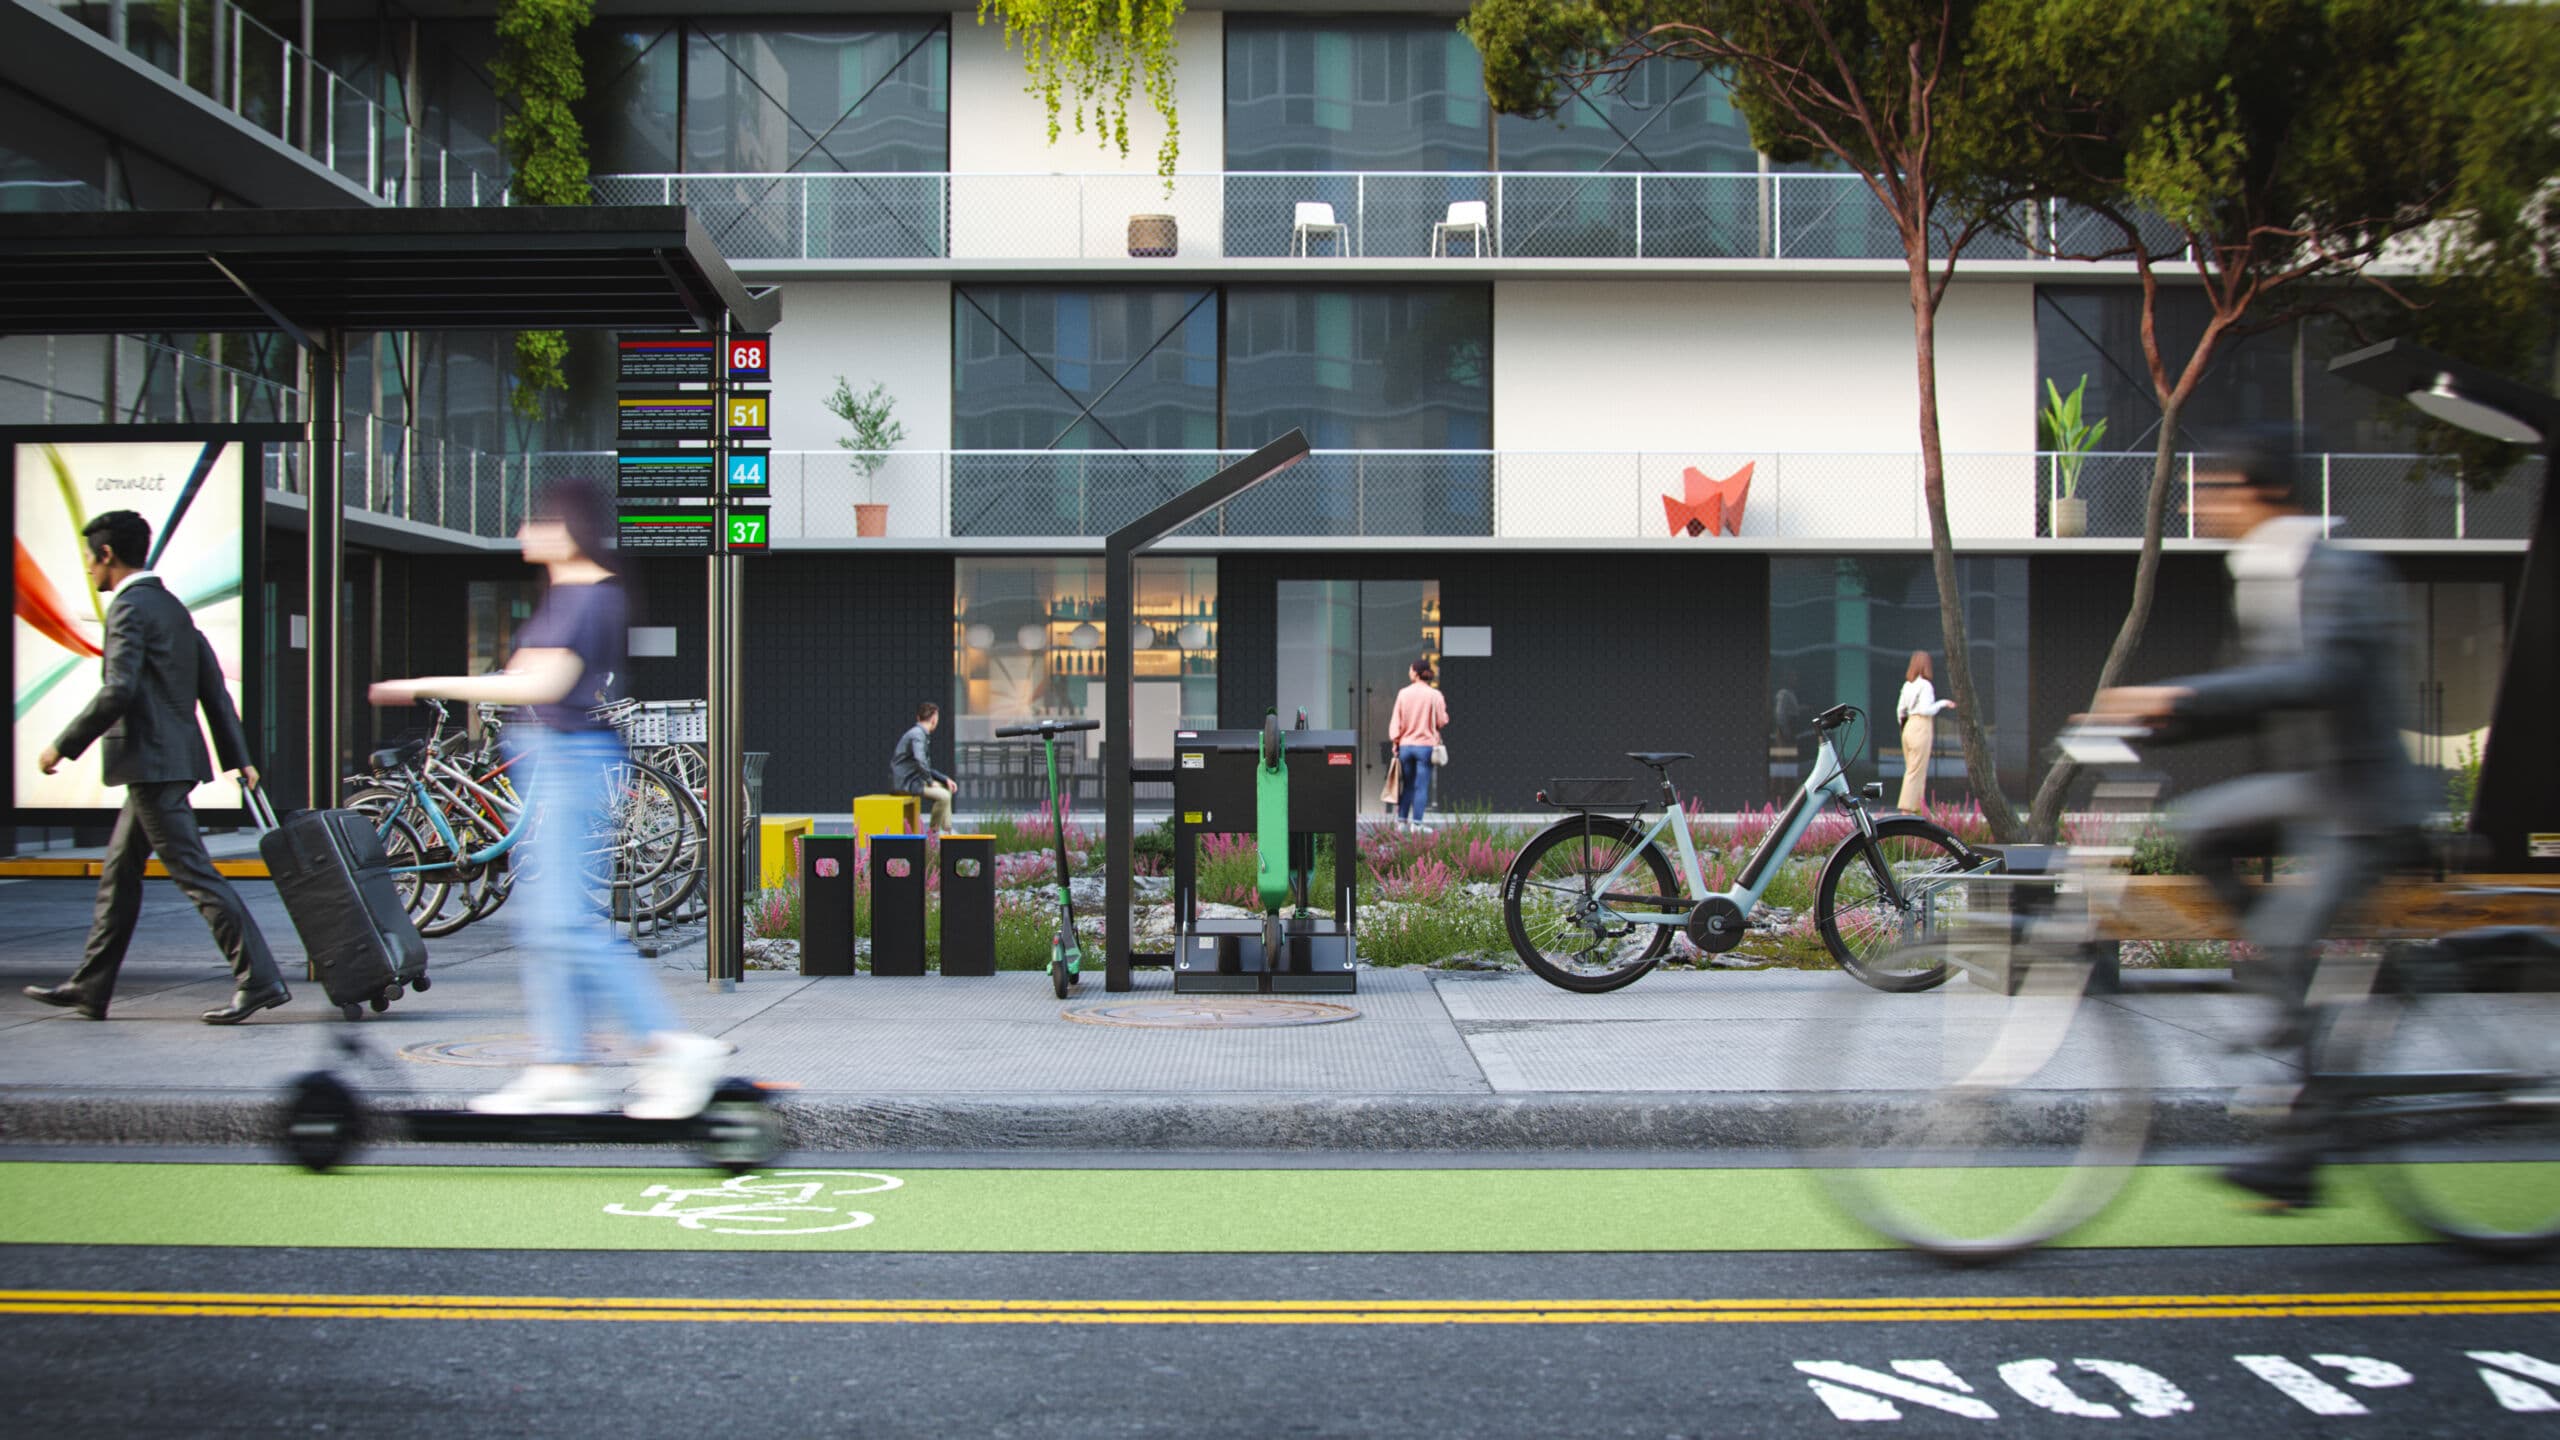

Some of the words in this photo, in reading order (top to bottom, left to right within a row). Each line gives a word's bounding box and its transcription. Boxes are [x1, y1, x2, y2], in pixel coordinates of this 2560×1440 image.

[734, 347, 761, 369] 68
[734, 405, 758, 427] 51
[733, 463, 761, 484] 44
[733, 522, 760, 543] 37
[1792, 1358, 2194, 1421] NO
